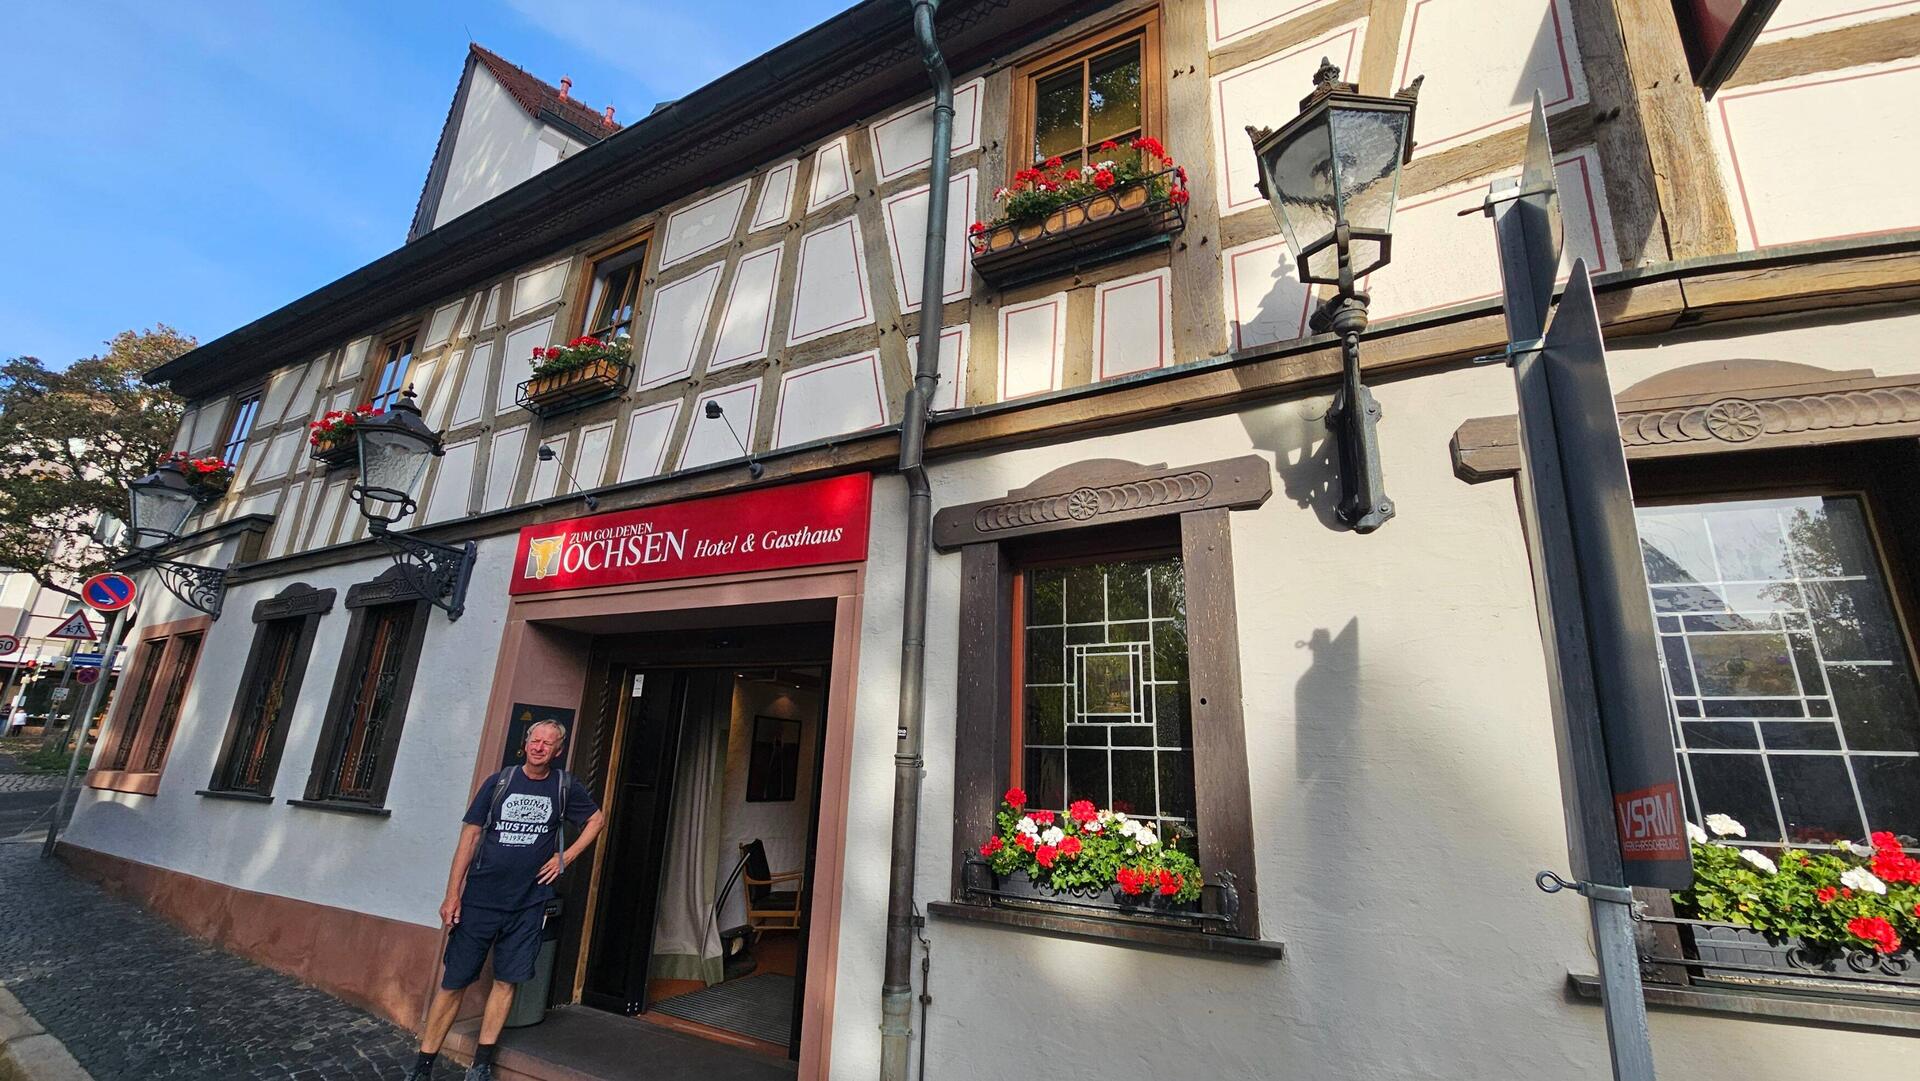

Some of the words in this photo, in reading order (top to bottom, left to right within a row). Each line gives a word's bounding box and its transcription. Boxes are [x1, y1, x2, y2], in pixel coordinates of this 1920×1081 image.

[569, 531, 593, 545] ZUM
[594, 522, 653, 540] GOLDENEN
[693, 535, 738, 558] Hotel
[741, 532, 756, 553] &
[762, 526, 843, 550] Gasthaus
[563, 529, 689, 573] OCHSEN
[506, 798, 549, 814] ORIGINAL
[1618, 792, 1677, 839] VSRM
[495, 821, 549, 834] MUSTANG
